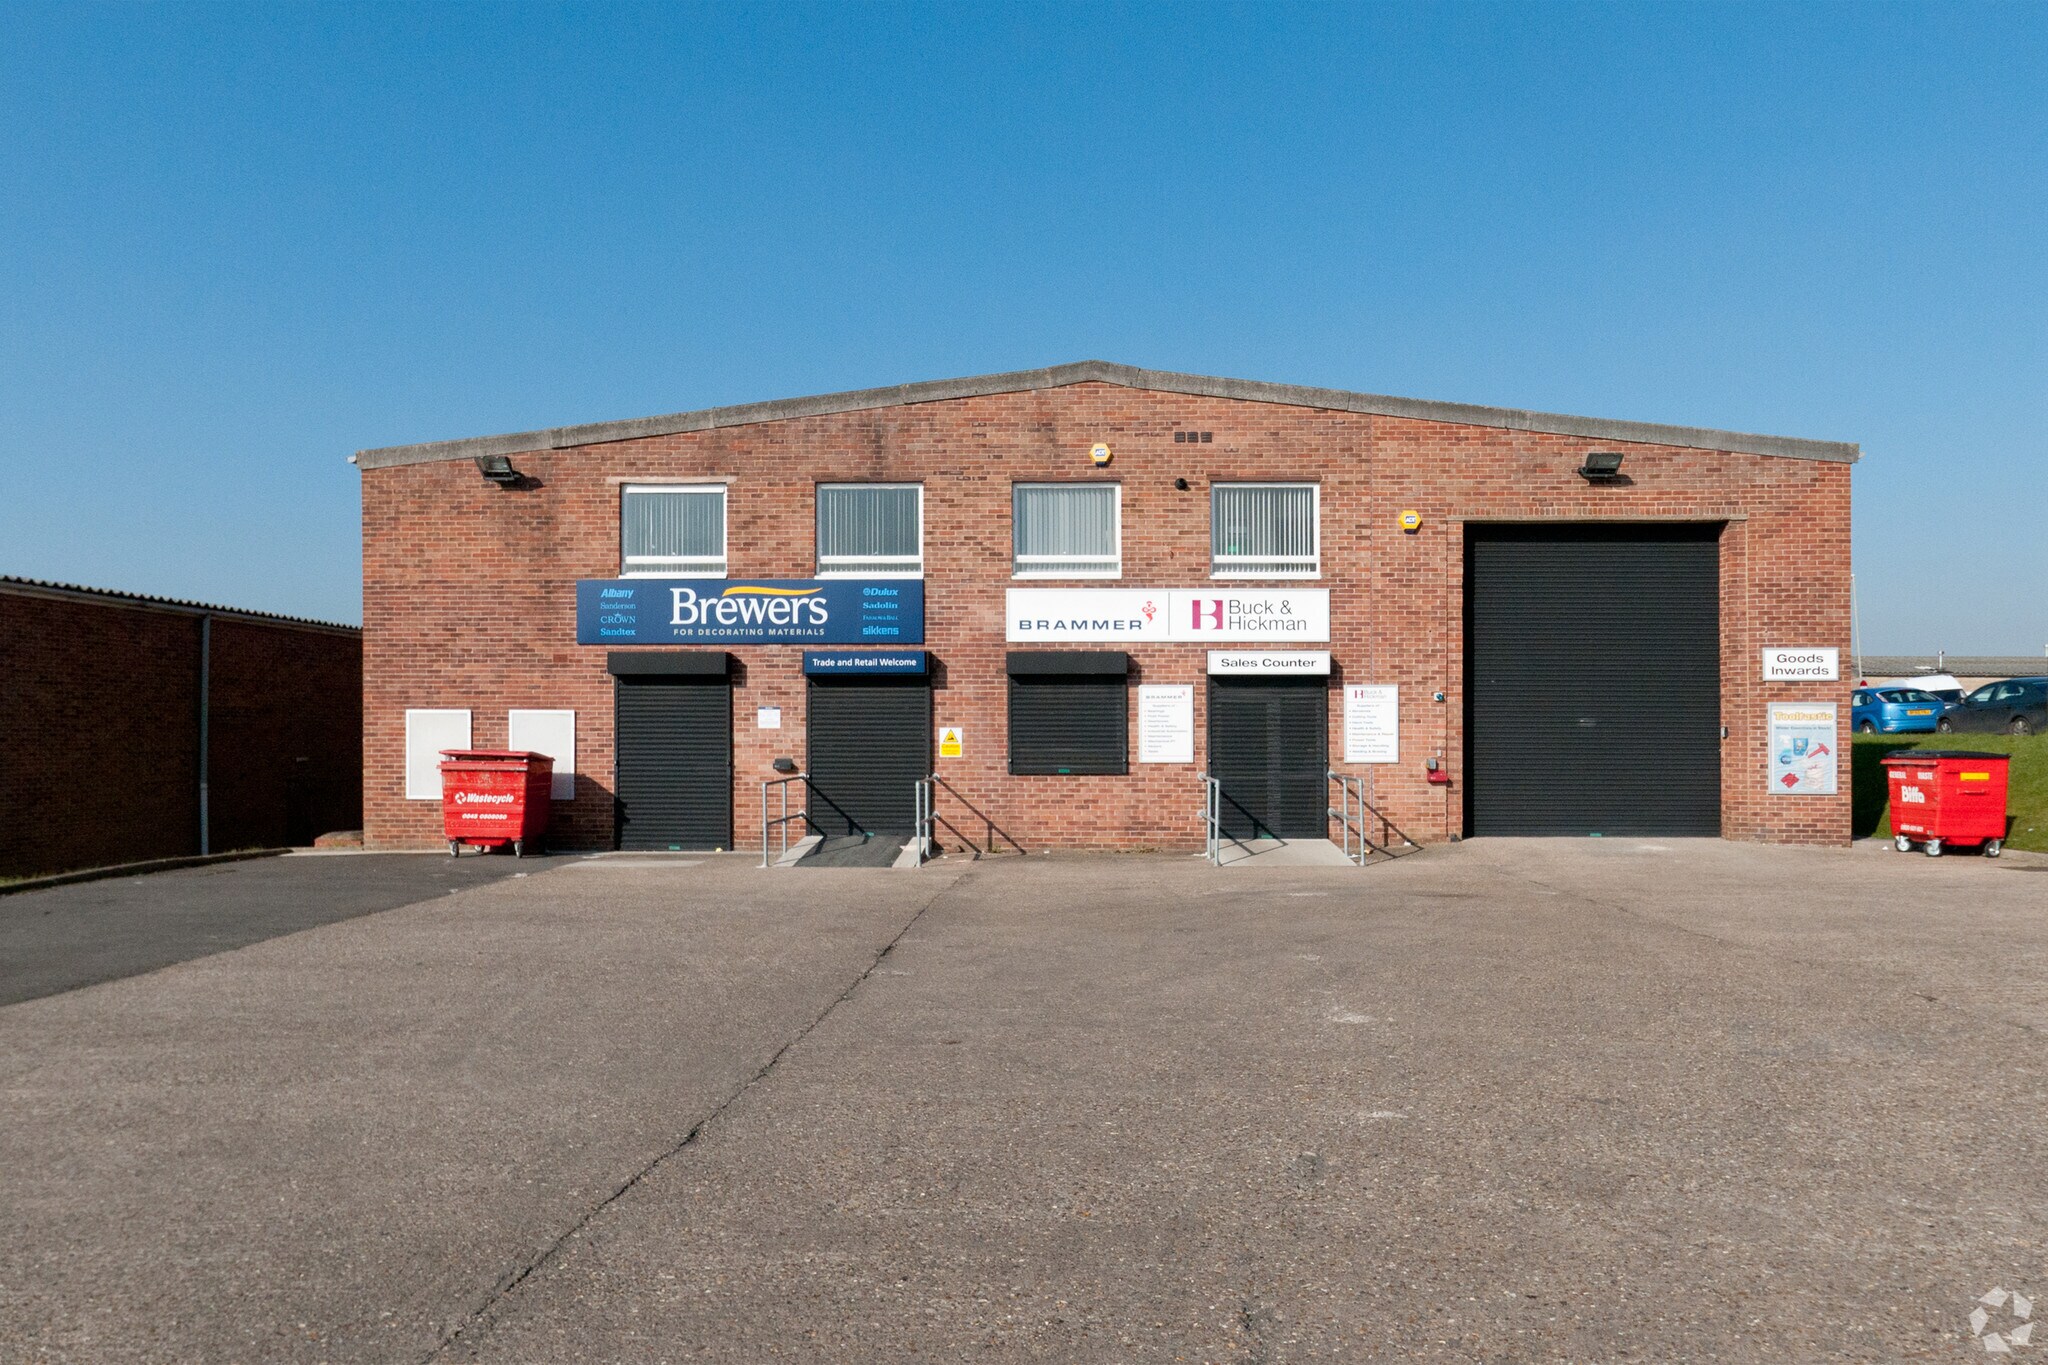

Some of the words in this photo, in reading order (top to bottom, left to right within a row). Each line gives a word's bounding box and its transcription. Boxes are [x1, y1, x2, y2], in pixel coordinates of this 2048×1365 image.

[600, 588, 634, 599] Albany
[870, 587, 899, 596] Dulux
[600, 602, 636, 610] Sanderson
[669, 587, 829, 625] Brewers
[862, 601, 898, 609] Sadolin
[1229, 599, 1274, 615] Buck
[1280, 599, 1293, 615] &
[600, 615, 636, 624] CROWN
[1229, 615, 1307, 631] Hickman
[1019, 619, 1143, 631] BRAMMER
[600, 627, 636, 636] Sandtex
[673, 628, 694, 636] FOR
[697, 628, 764, 636] DECORATING
[768, 628, 825, 636] MATERIALS
[862, 626, 899, 635] sikkens
[812, 658, 836, 667] Trade
[837, 658, 853, 667] and
[854, 658, 878, 667] Retail
[879, 658, 917, 667] Welcome
[1221, 658, 1258, 668] Sales
[1262, 658, 1317, 668] Counter
[1776, 653, 1824, 664] Goods
[1771, 666, 1829, 676] Inwards
[466, 792, 515, 805] Wastecycle
[1901, 785, 1925, 803] Biffa
